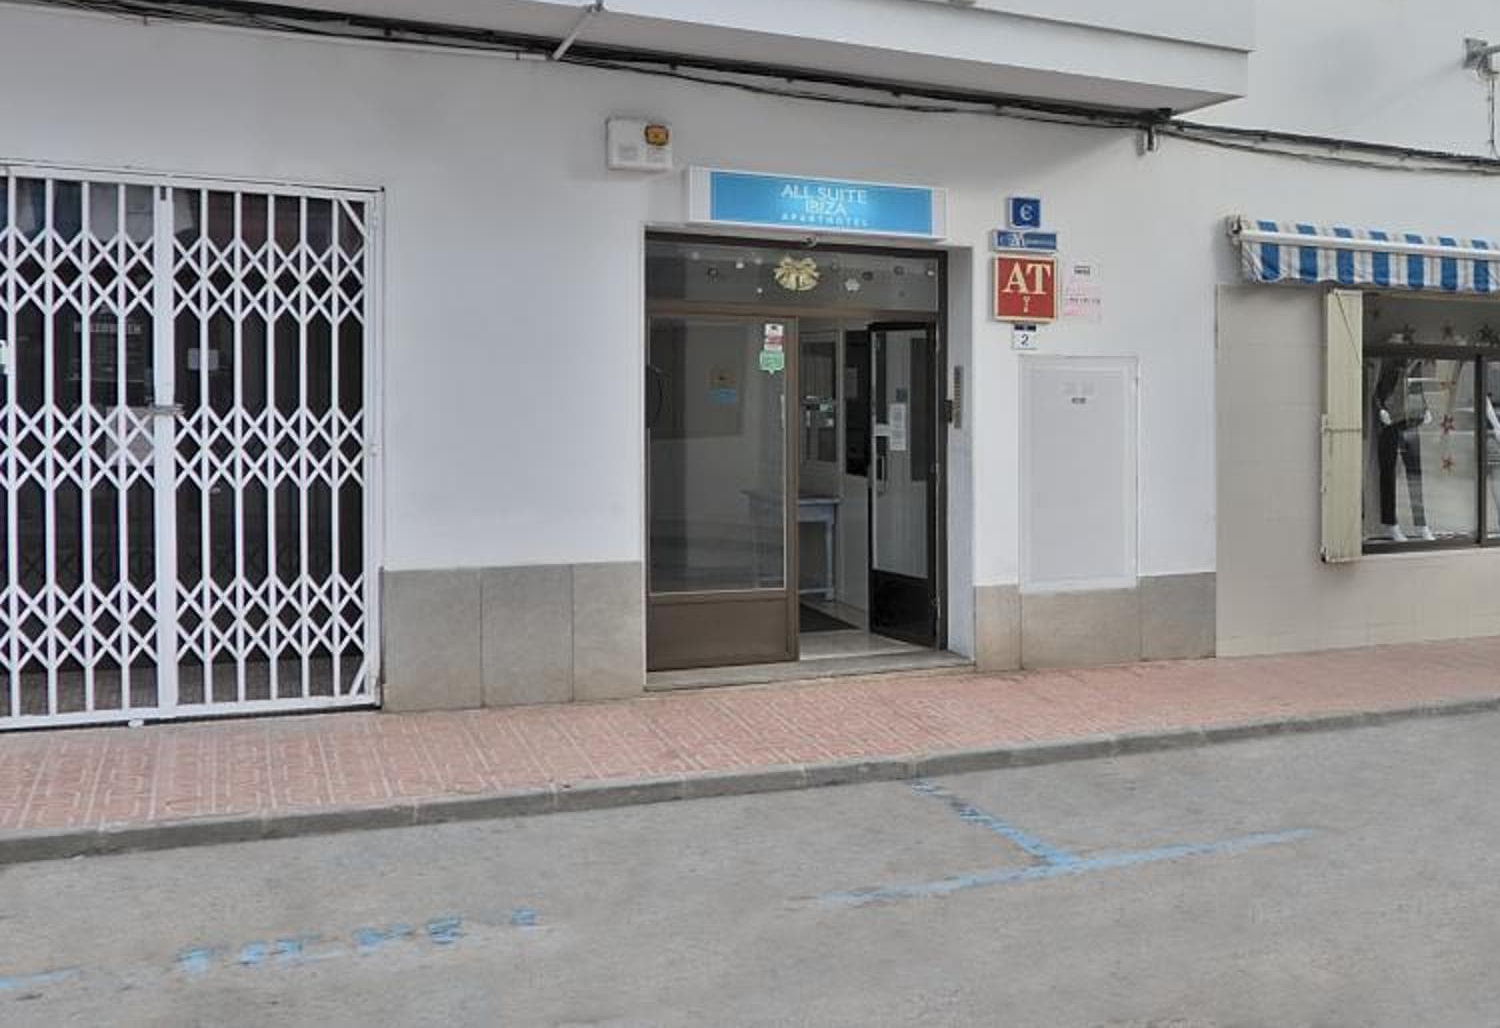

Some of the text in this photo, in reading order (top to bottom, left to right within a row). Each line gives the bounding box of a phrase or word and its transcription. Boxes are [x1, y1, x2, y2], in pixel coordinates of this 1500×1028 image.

[781, 183, 868, 205] ALL SUITE
[805, 198, 848, 217] IBIZA
[1001, 260, 1051, 295] AT
[1020, 333, 1030, 347] 2
